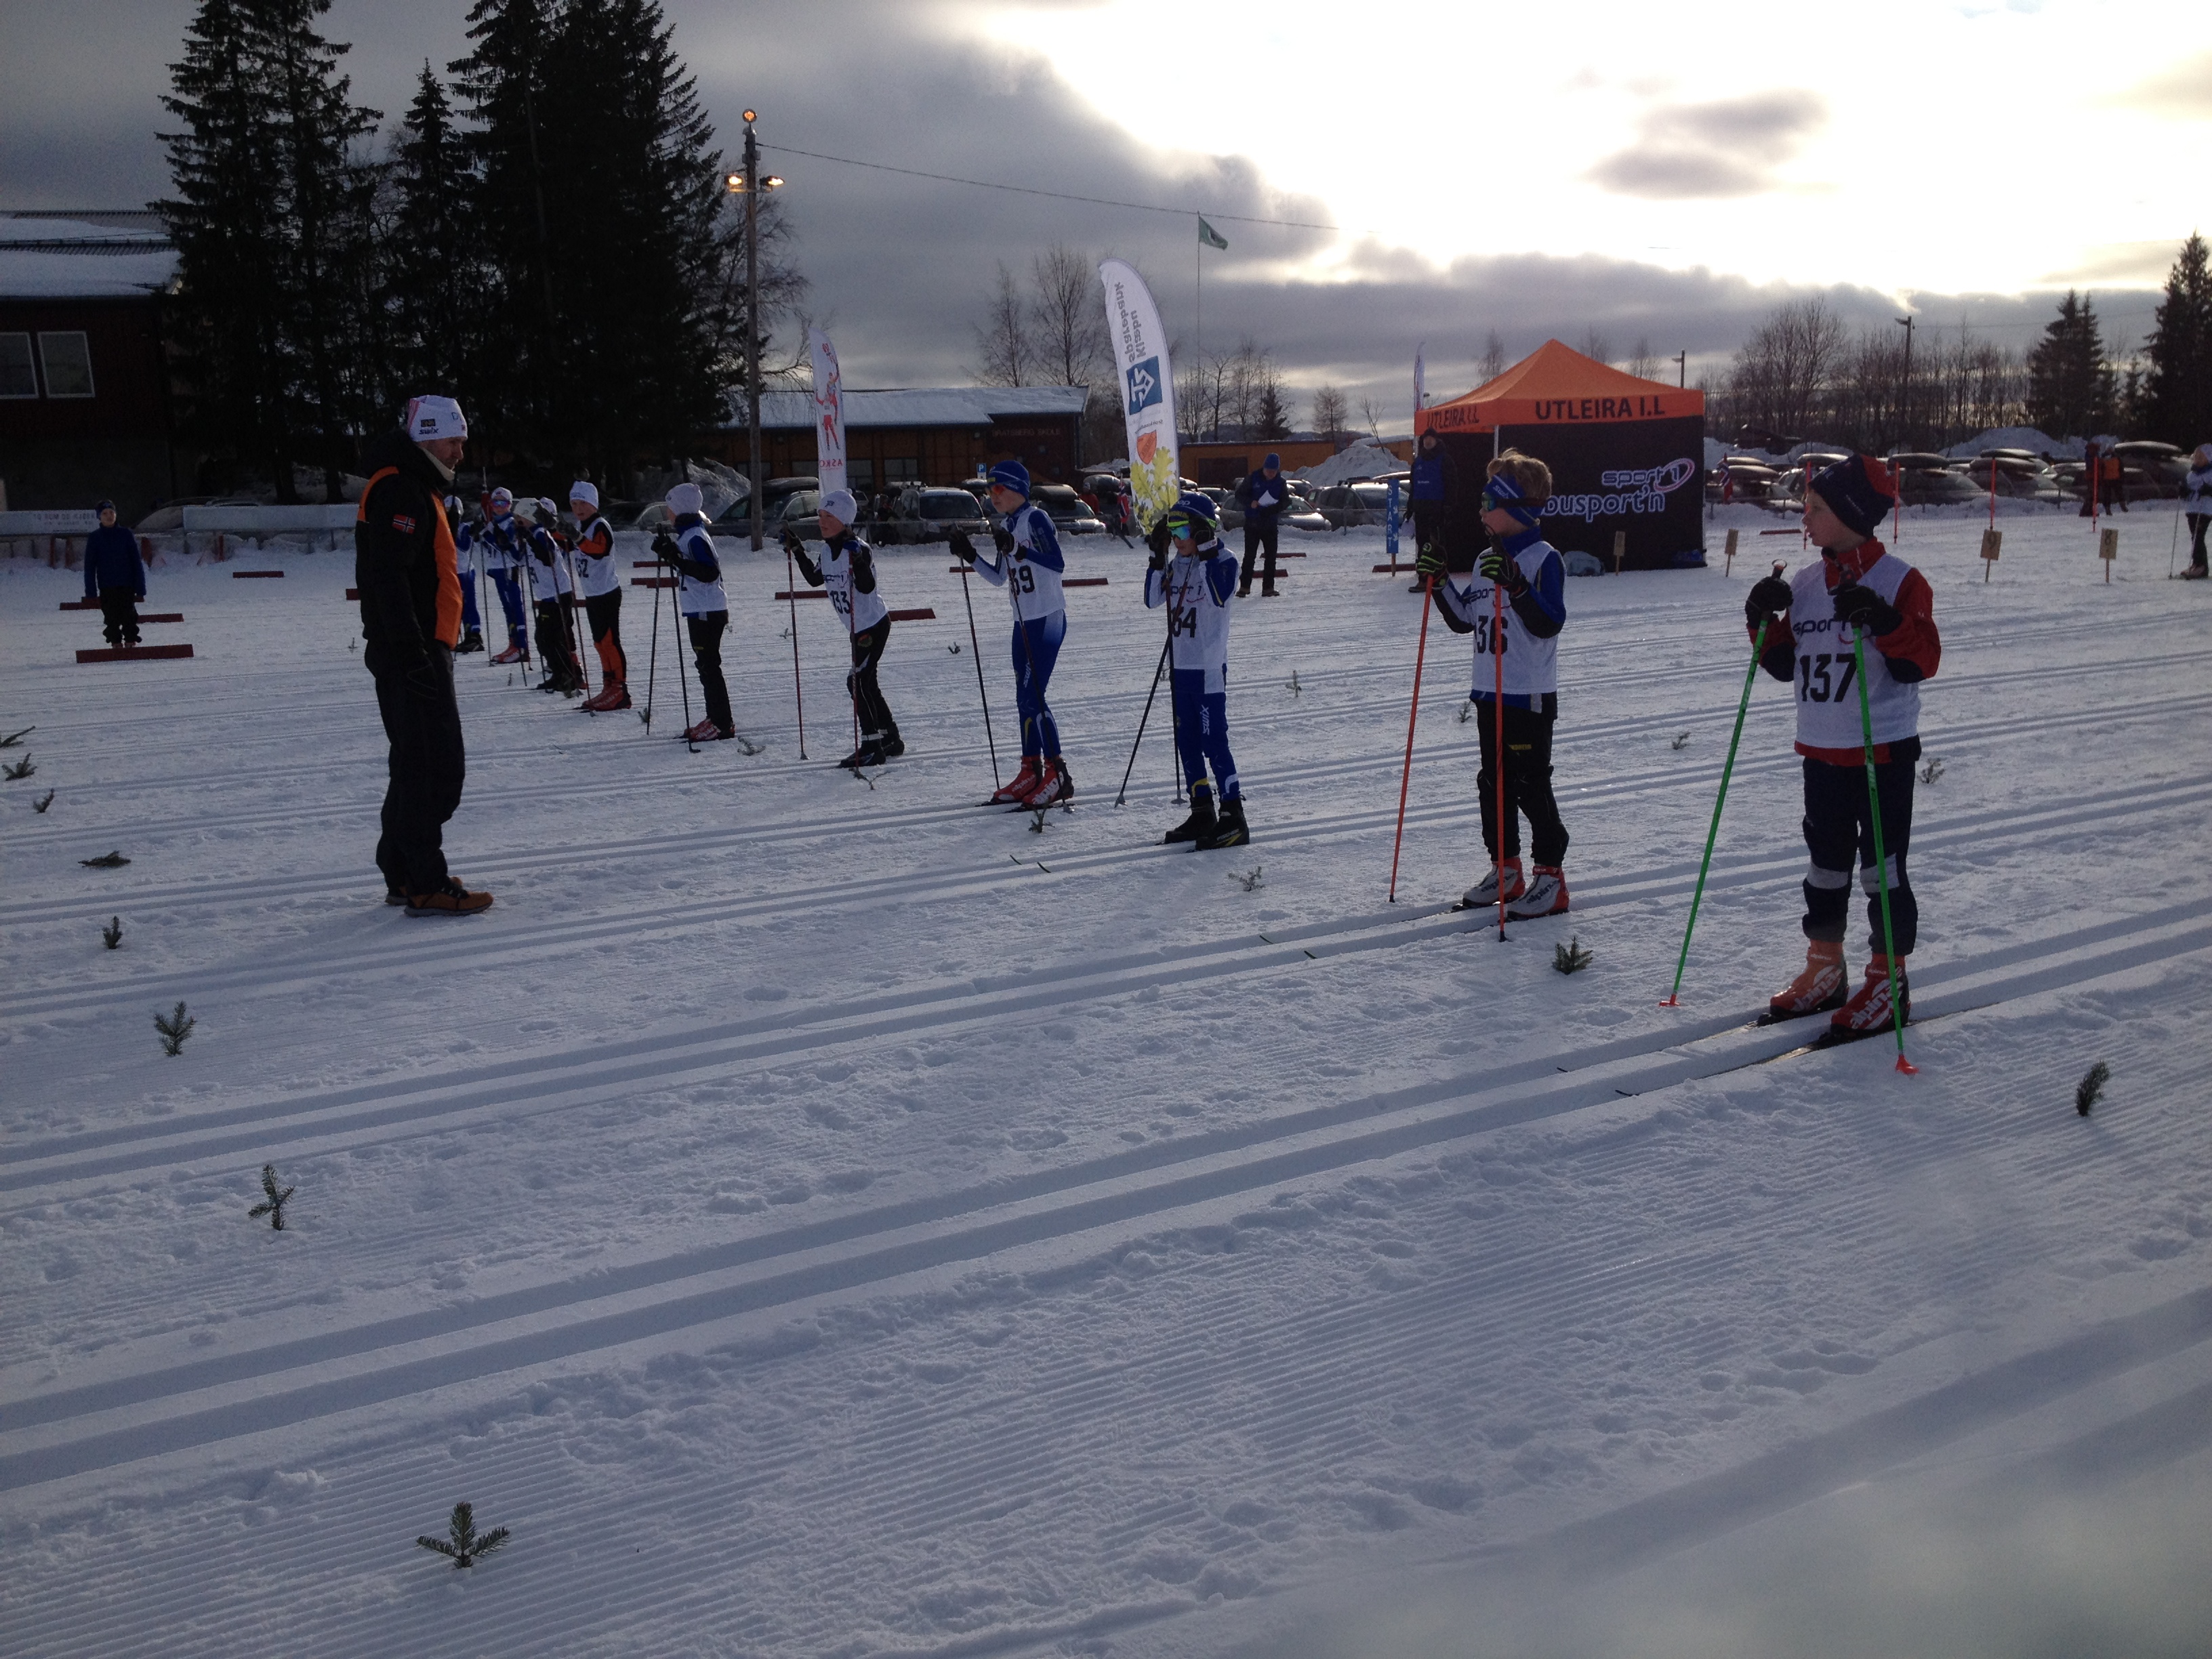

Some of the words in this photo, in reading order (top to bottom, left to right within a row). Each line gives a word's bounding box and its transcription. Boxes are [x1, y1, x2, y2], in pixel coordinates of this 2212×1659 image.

[1427, 407, 1466, 429] UTLEIRA
[1536, 397, 1633, 420] UTLEIRA
[1474, 615, 1508, 655] 36
[1799, 653, 1857, 703] 137
[1200, 704, 1210, 736] swix
